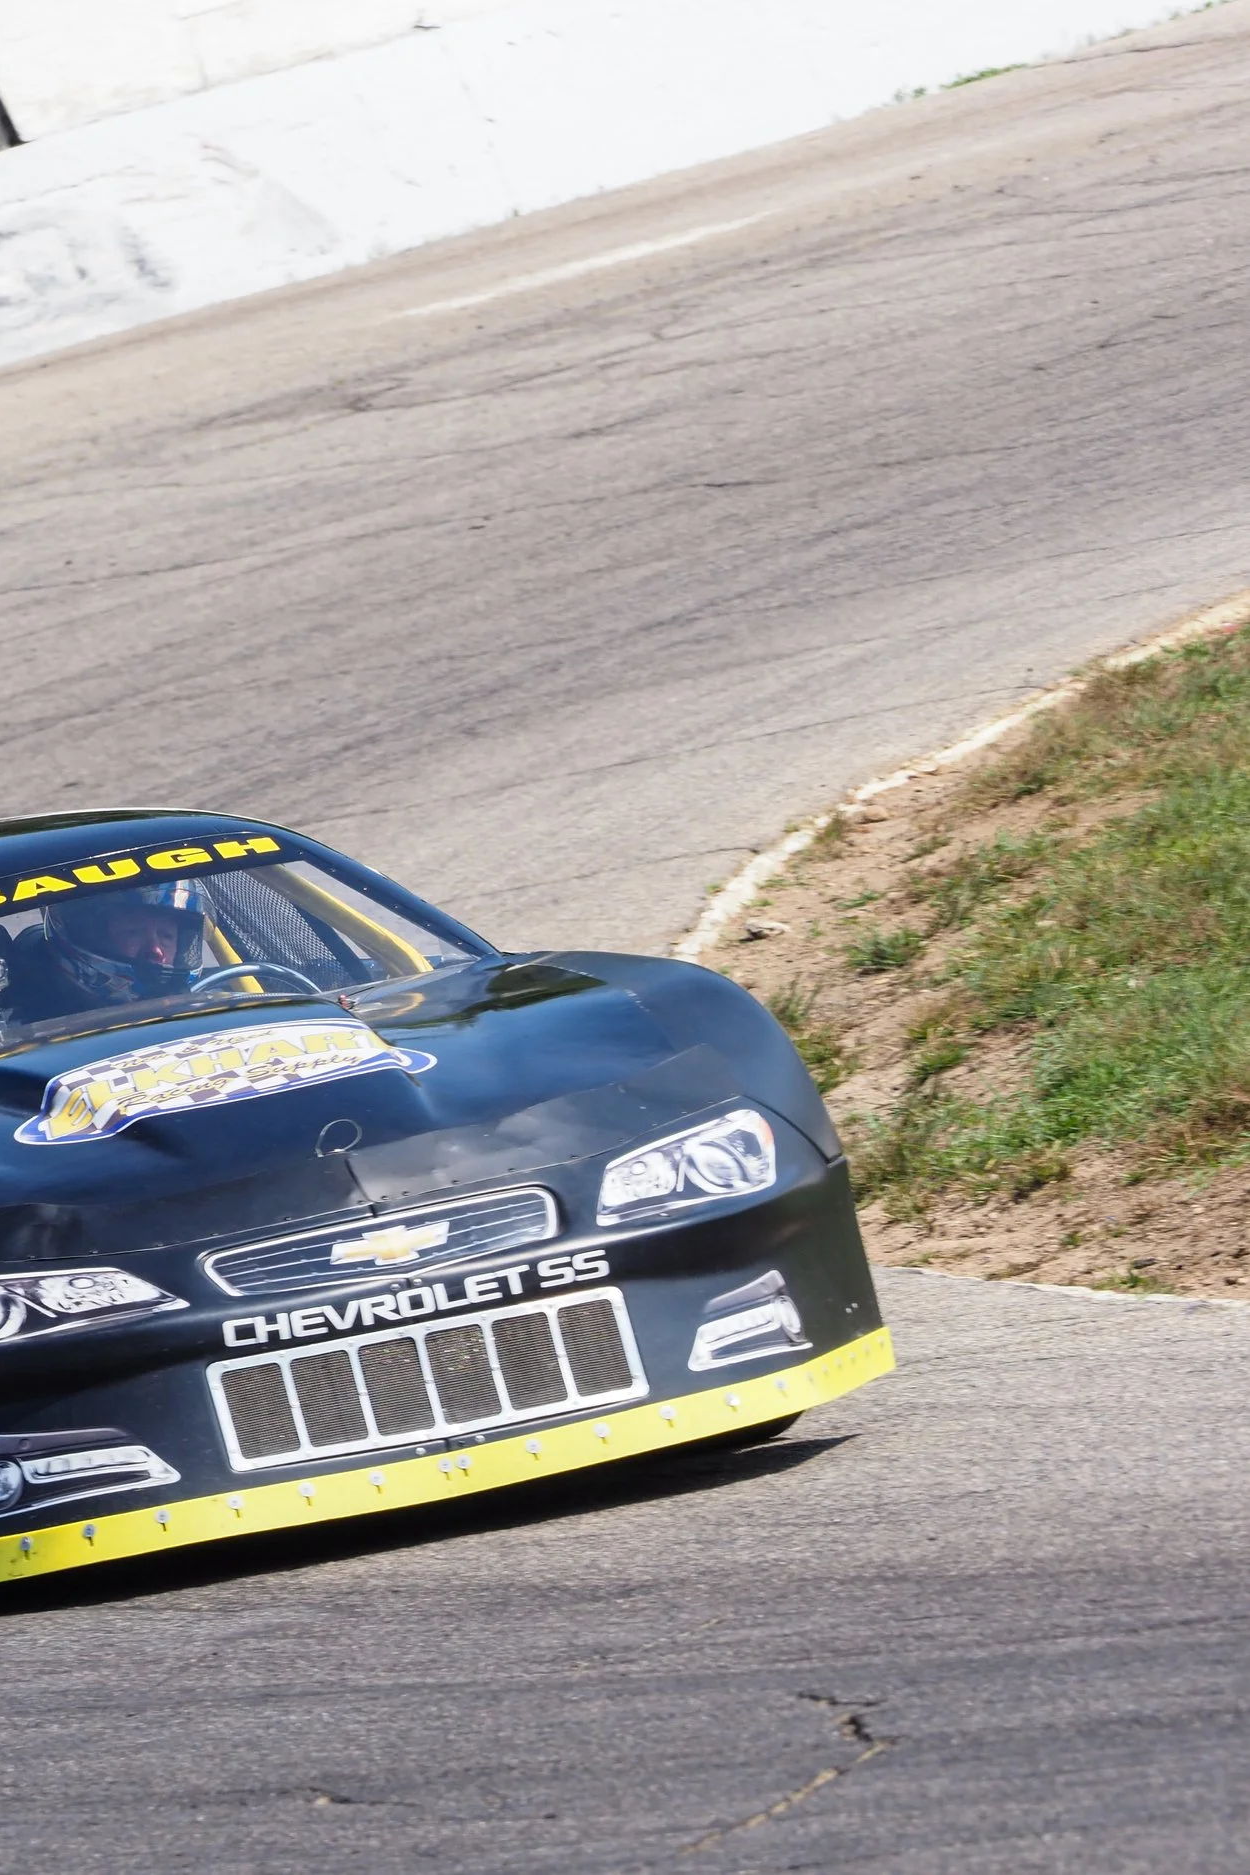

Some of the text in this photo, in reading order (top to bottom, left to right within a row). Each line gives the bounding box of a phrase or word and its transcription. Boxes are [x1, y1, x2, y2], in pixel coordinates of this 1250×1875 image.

[46, 1029, 391, 1140] ELKHART
[117, 1053, 364, 1114] Racing Supply
[221, 1248, 611, 1348] CHEVROLET SS
